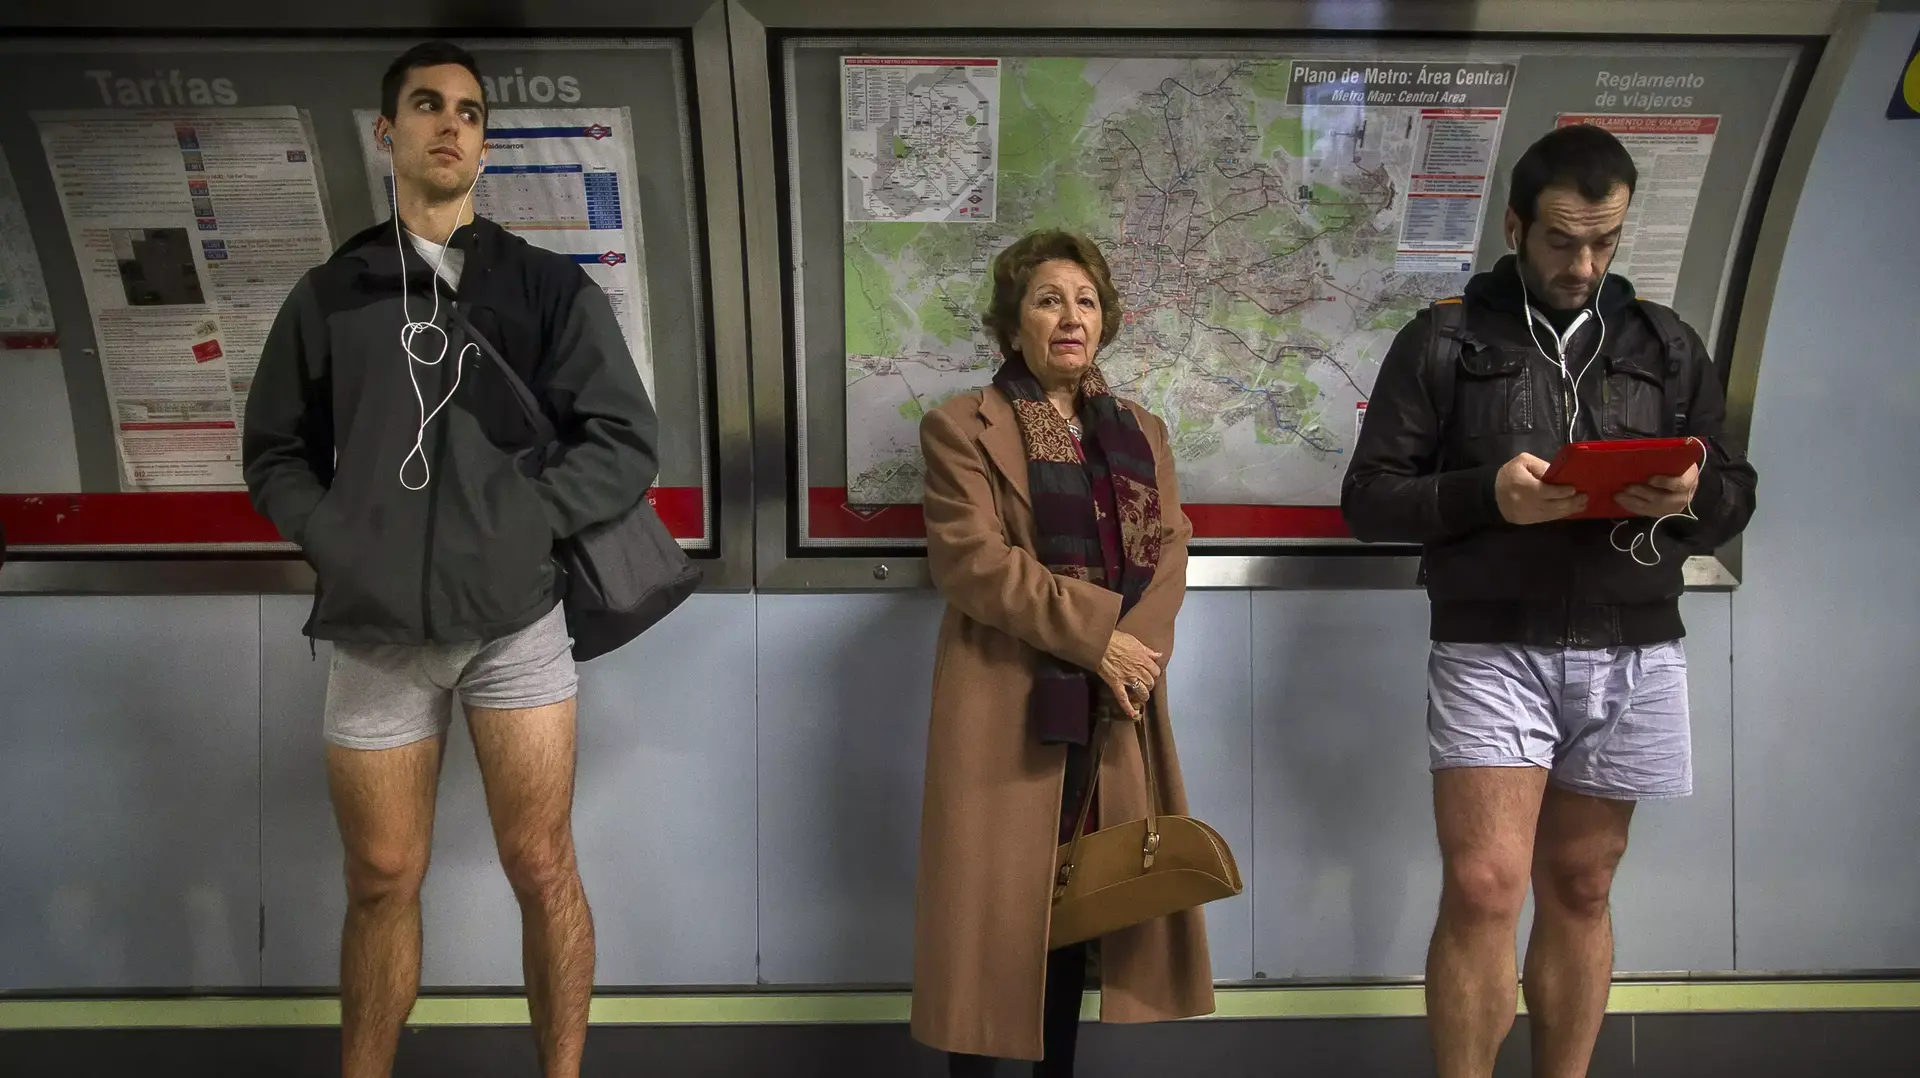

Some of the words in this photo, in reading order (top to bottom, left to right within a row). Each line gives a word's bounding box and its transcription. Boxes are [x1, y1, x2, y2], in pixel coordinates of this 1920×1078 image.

[482, 67, 581, 103] arios
[1293, 66, 1336, 84] Plano
[1341, 67, 1359, 84] de
[1364, 67, 1413, 85] Metro:
[1416, 64, 1451, 85] Área
[1456, 68, 1510, 86] Central
[1596, 71, 1704, 91] Reglamento
[84, 68, 238, 105] Tarifas
[1332, 90, 1364, 102] Metro
[1367, 90, 1395, 104] Map:
[1398, 90, 1439, 103] Central
[1440, 91, 1466, 103] Area
[1595, 91, 1616, 106] de
[1623, 92, 1694, 111] viajeros
[1583, 117, 1642, 126] REGLAMENTO
[1659, 119, 1701, 127] VIAJEROS
